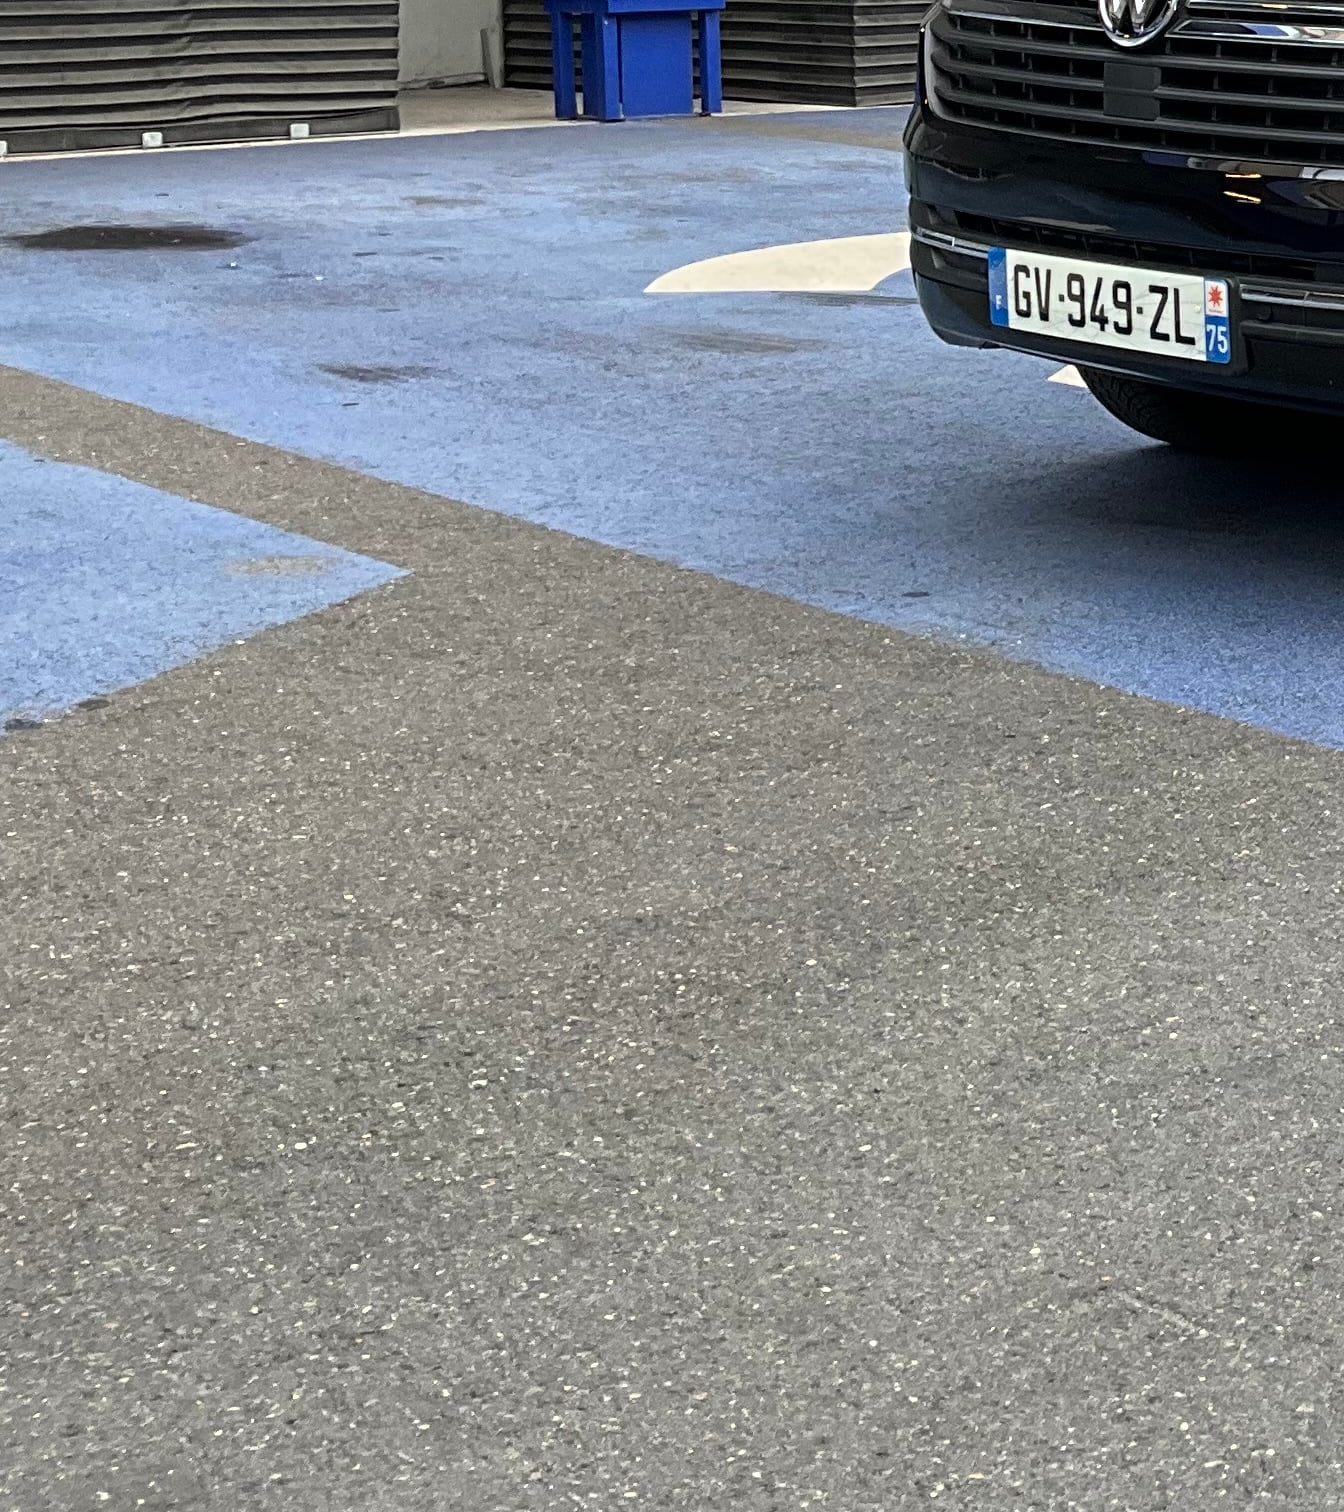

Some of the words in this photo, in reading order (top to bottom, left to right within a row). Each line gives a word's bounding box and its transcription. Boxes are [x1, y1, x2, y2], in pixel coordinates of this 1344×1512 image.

[994, 294, 1002, 310] F
[1013, 263, 1196, 346] GV-949-ZL
[1206, 323, 1228, 354] 75
